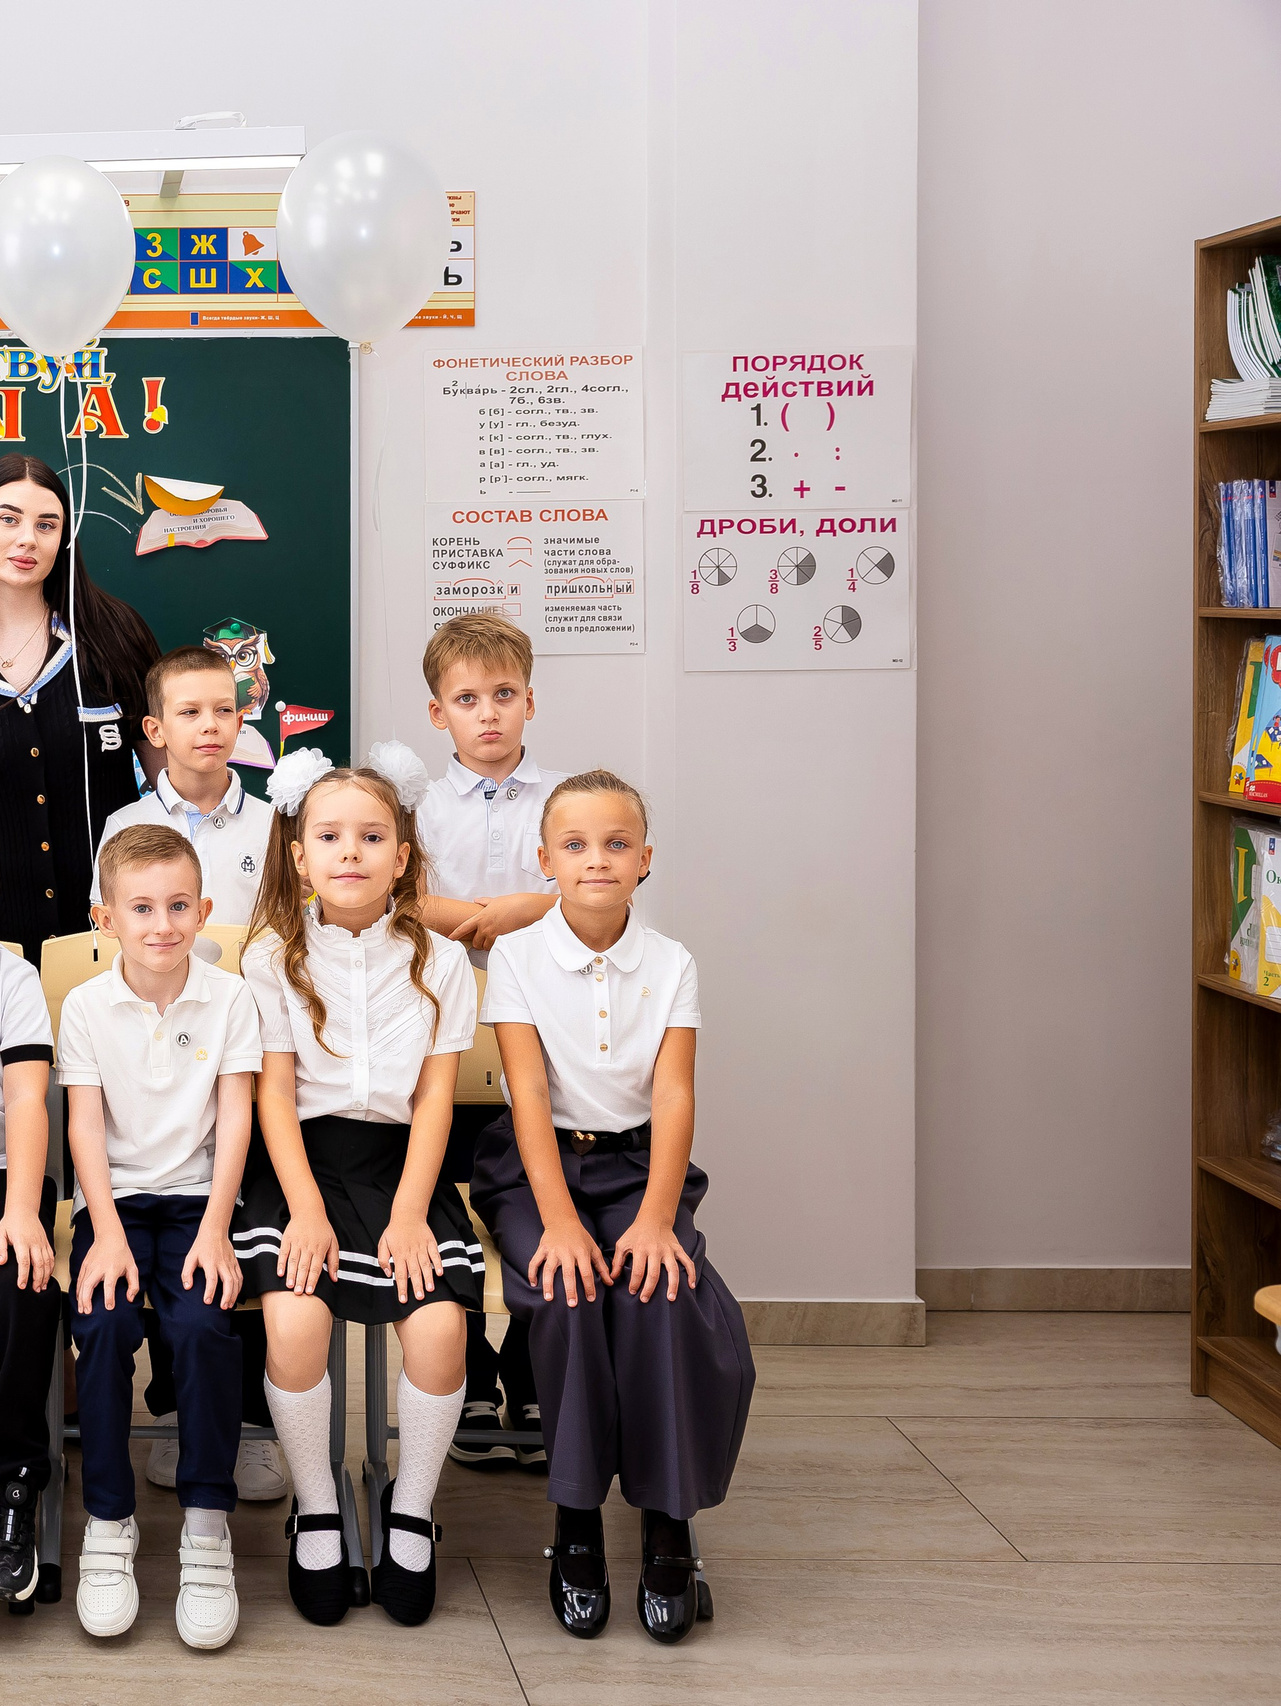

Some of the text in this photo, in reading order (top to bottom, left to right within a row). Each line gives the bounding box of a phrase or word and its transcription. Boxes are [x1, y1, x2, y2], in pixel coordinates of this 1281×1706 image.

[143, 267, 161, 289] с
[245, 268, 265, 288] х
[432, 354, 634, 369] ФОНЕТИЧЕСКИЙ РАЗБОР
[732, 354, 864, 374] ПОРЯДОК
[506, 370, 568, 382] СЛОВА
[581, 385, 629, 394] 4согл.,
[721, 374, 874, 402] действий
[750, 403, 768, 426] 1.
[540, 420, 580, 428] безуд.
[750, 439, 772, 462] 2.
[750, 474, 772, 498] 3.
[452, 508, 609, 524] СОСТАВ СЛОВА
[164, 524, 206, 533] НАСТРОЕНИЯ
[696, 518, 897, 538] ДРОБИ, ДОЛИ
[432, 537, 480, 546] КОРЕНЬ
[432, 549, 504, 558] ПРИСТАВКА
[432, 560, 491, 570] СУФФИКС
[544, 559, 578, 567] (служат
[609, 566, 634, 574] слов)
[545, 614, 578, 623] (служит
[574, 624, 635, 633] предложении)
[282, 710, 328, 726] финиш
[1263, 977, 1269, 986] 2
